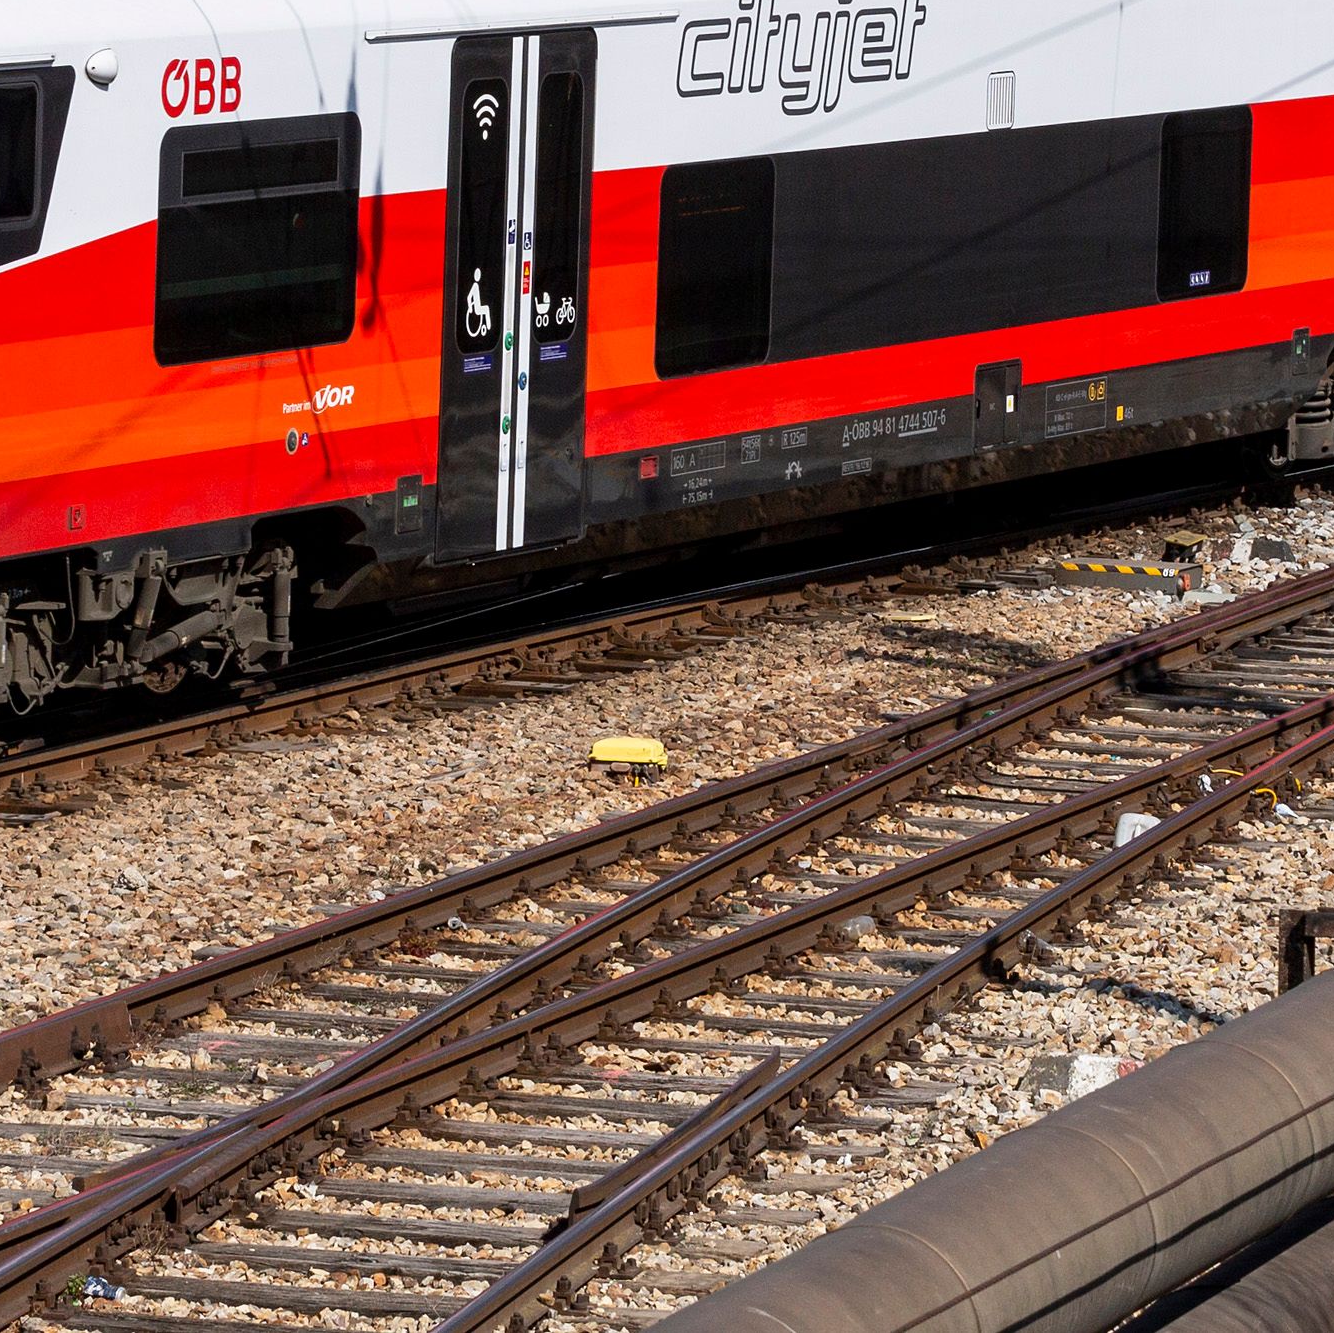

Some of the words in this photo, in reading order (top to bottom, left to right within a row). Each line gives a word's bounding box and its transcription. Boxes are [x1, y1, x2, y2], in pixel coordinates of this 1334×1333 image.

[161, 56, 242, 119] ÖBB
[282, 401, 303, 414] Partner
[313, 384, 355, 413] VOR
[872, 419, 884, 436] 94
[885, 417, 896, 434] 81
[898, 413, 920, 433] 4744
[921, 408, 946, 429] 507-6
